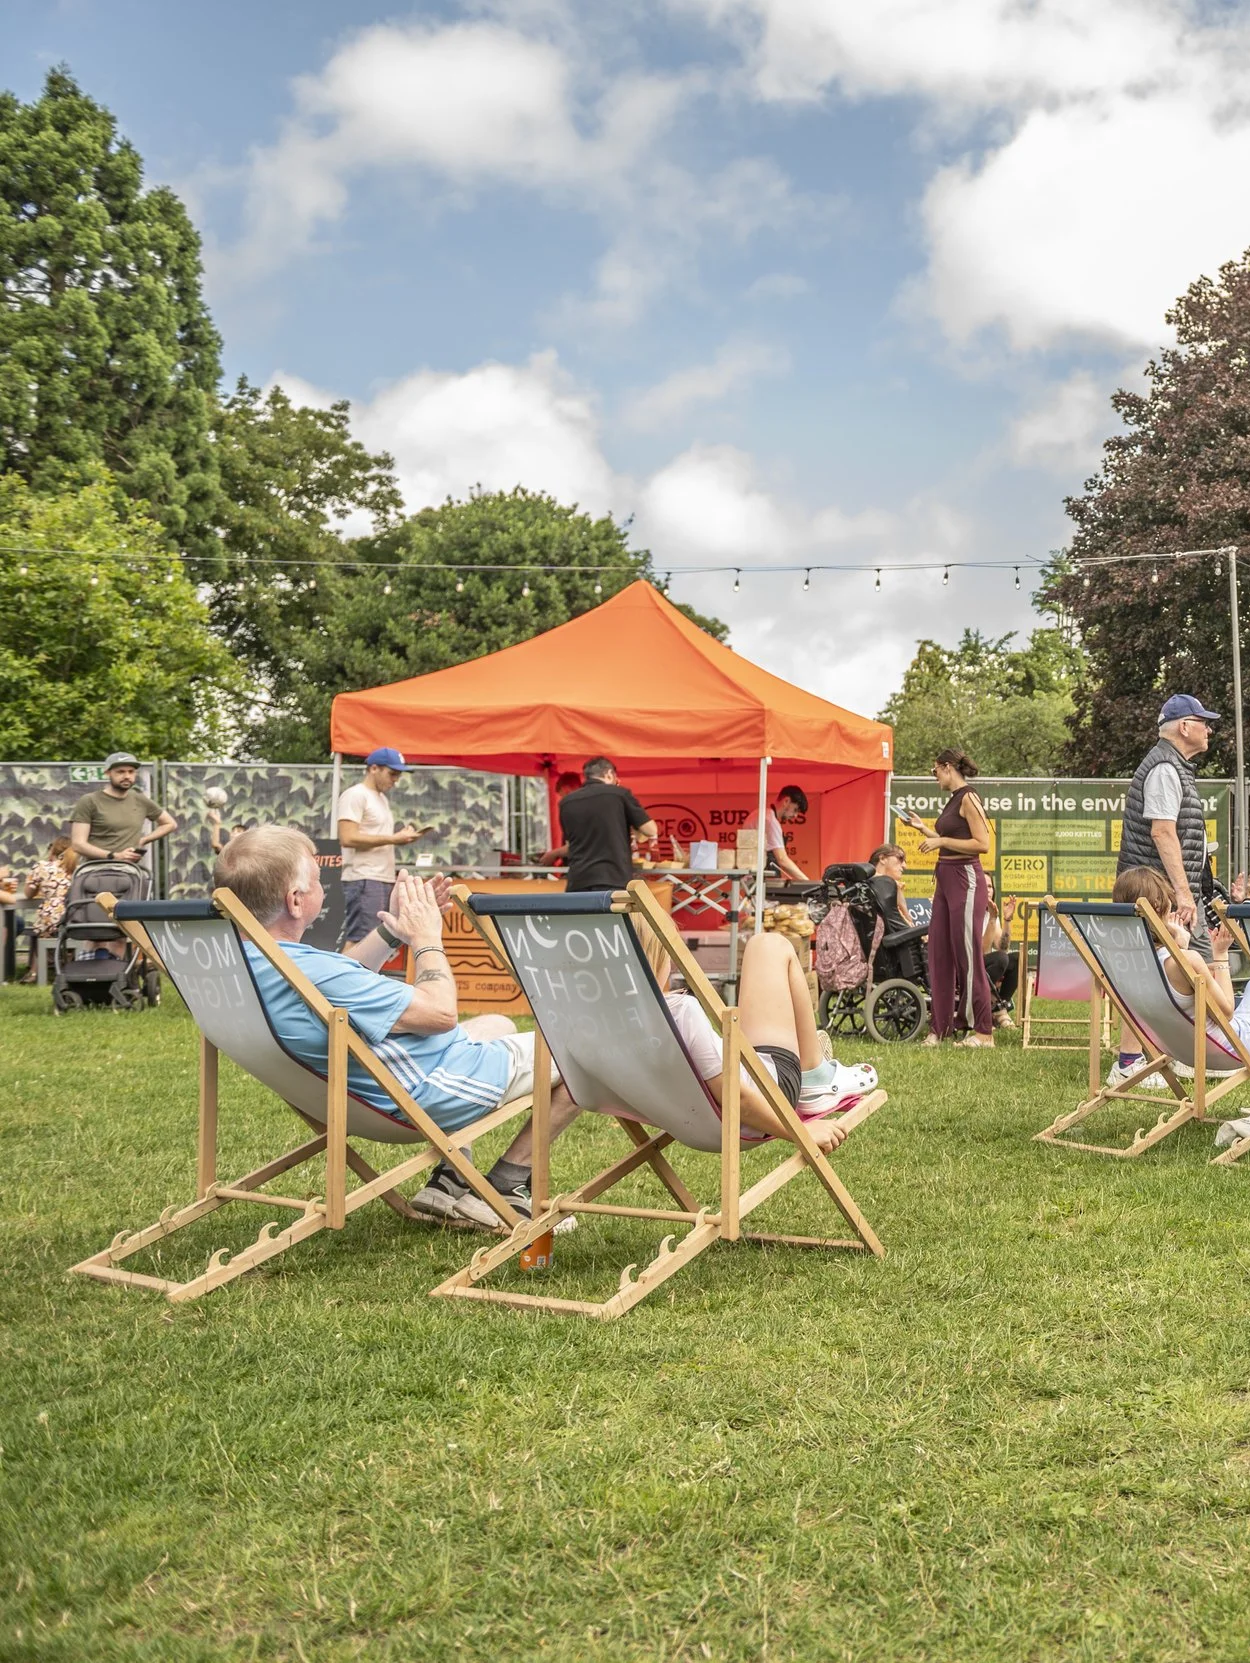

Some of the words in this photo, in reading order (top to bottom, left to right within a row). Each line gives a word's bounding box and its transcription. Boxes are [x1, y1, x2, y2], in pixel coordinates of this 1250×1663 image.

[896, 793, 1012, 814] storyuse
[1018, 793, 1036, 811] in
[1041, 793, 1076, 811] the
[1004, 859, 1044, 870] ZERO
[475, 982, 517, 993] company
